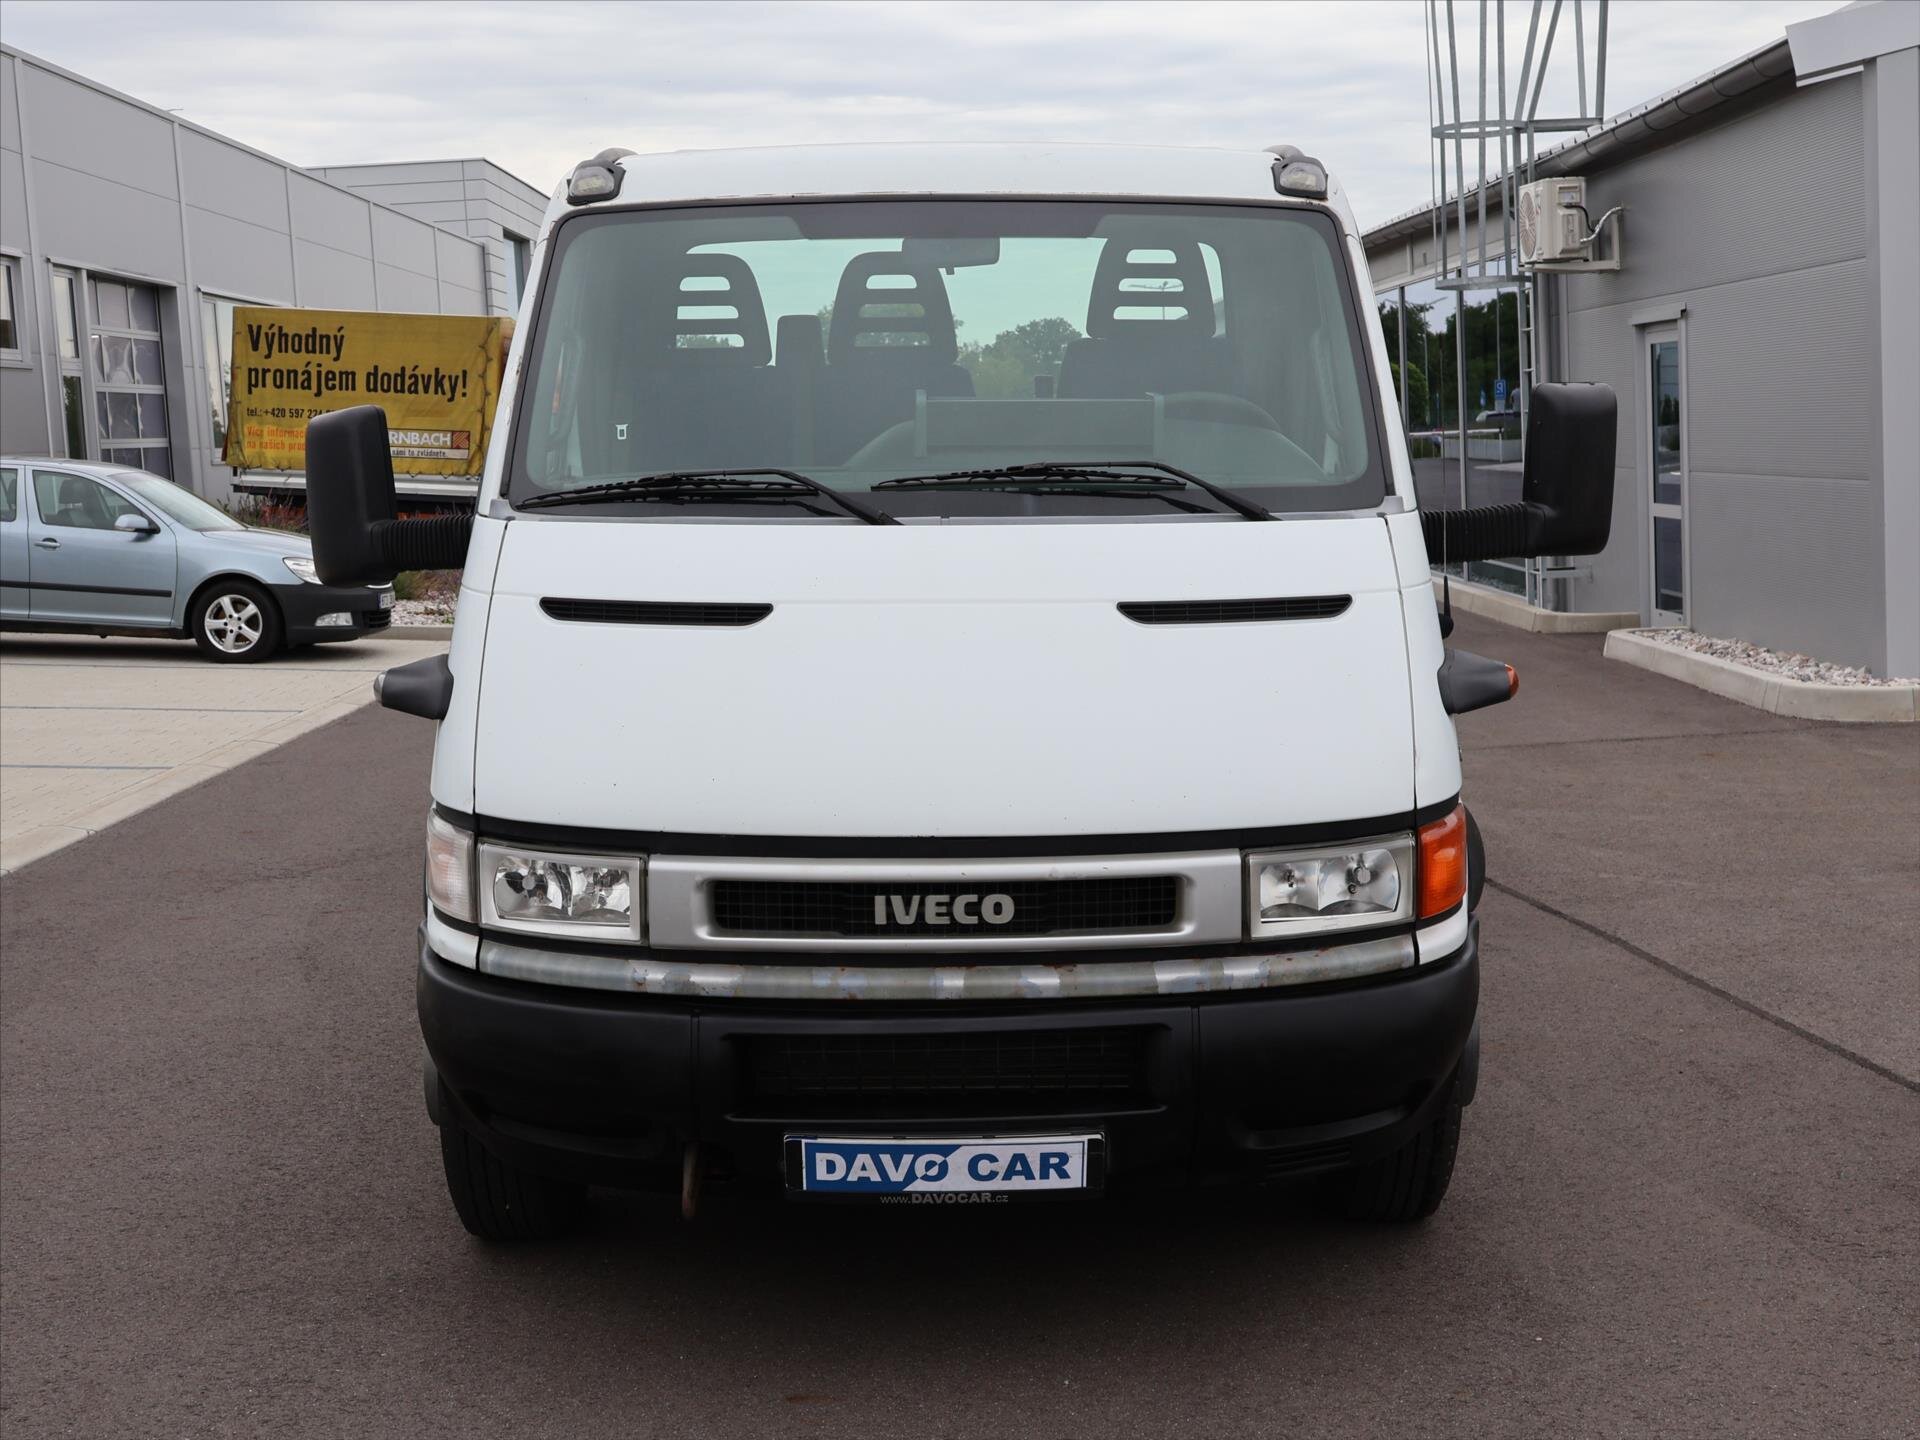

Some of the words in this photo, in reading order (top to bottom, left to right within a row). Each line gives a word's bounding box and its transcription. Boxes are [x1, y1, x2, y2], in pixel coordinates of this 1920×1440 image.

[247, 323, 345, 362] Výhodný
[247, 361, 357, 397] pronájem
[365, 364, 468, 402] dodávky!
[288, 408, 305, 419] 597
[874, 894, 1015, 925] IVECO
[815, 1152, 950, 1182] DAVO
[967, 1152, 1072, 1182] CAR
[880, 1192, 1009, 1205] www.DAVOCAR.cz
